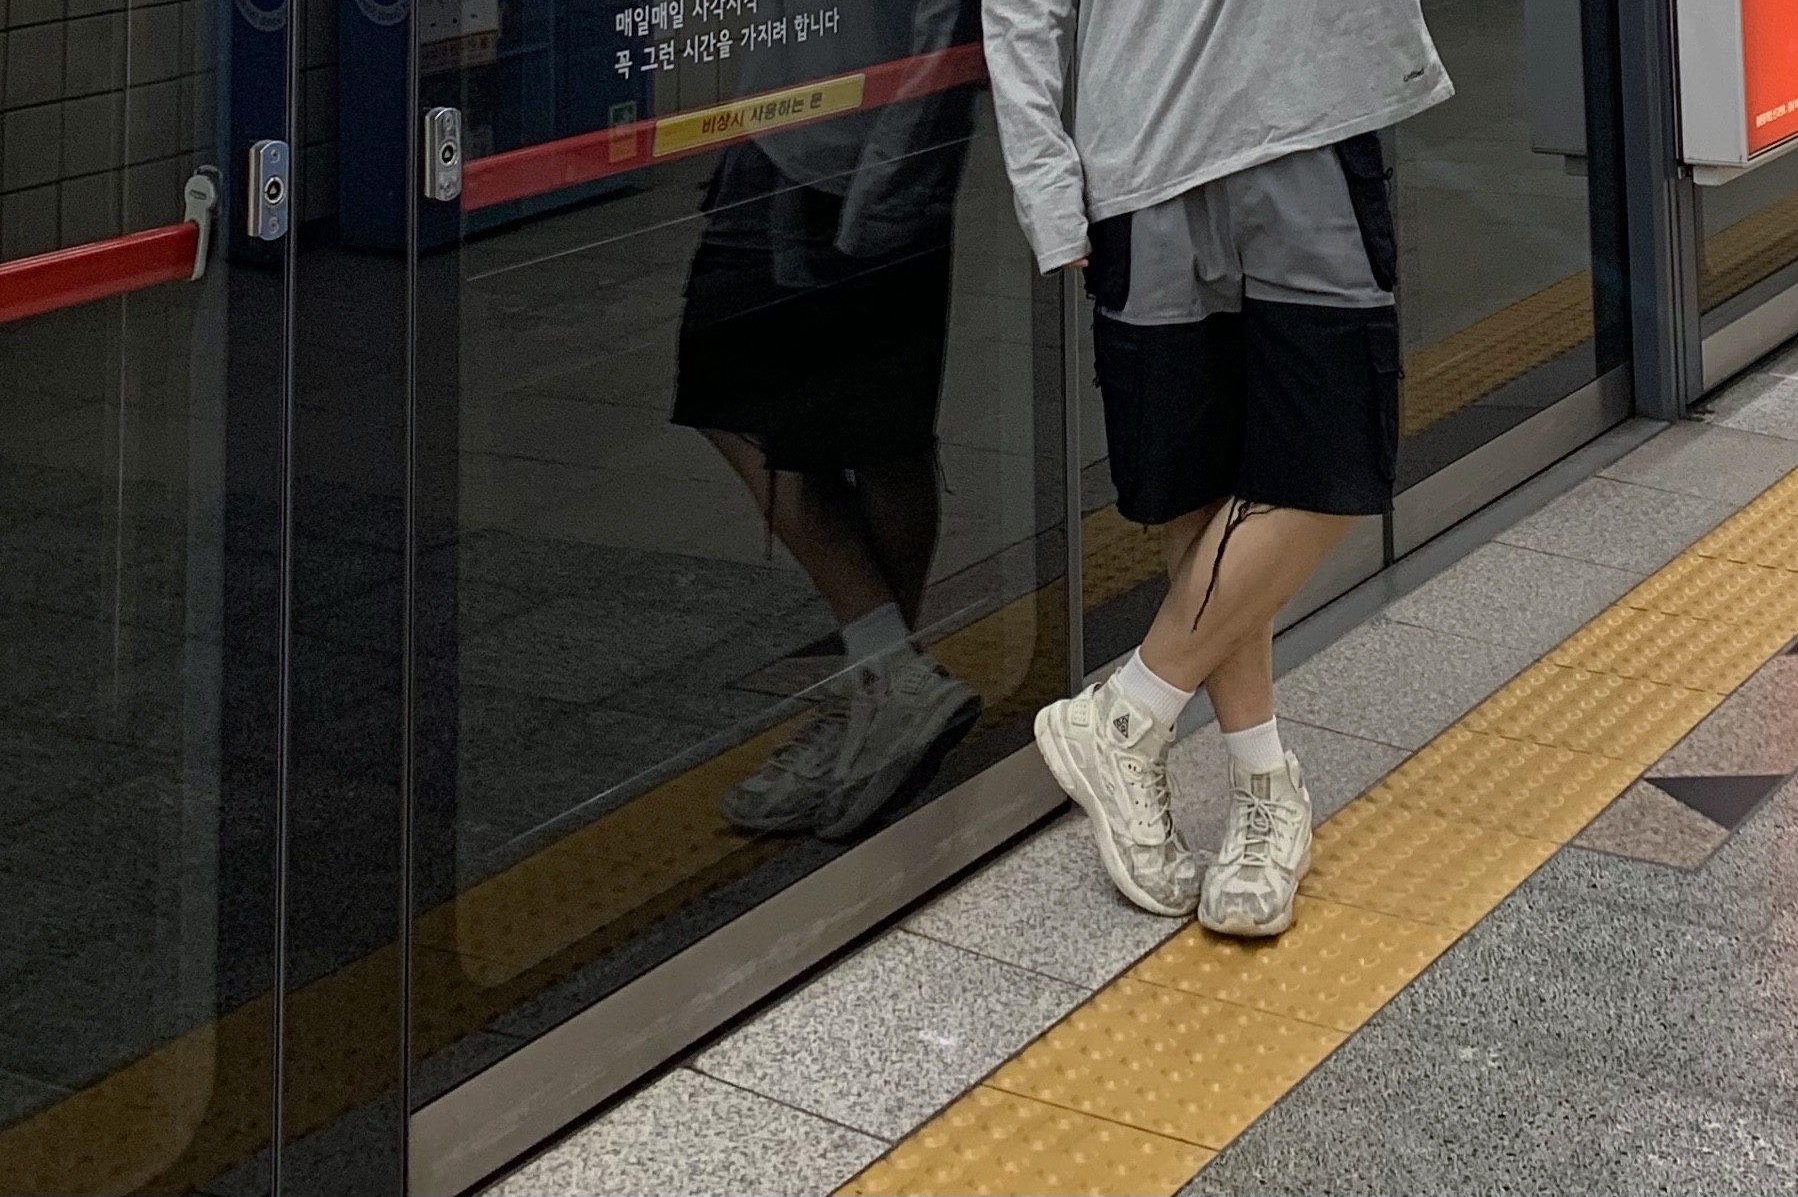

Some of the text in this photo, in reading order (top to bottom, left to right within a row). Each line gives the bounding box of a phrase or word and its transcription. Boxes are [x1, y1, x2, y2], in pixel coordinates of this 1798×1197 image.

[615, 0, 685, 38] 매일매일
[614, 6, 840, 80] 꼭 그런 시간을 가지려 합니다
[702, 92, 823, 135] 비상시 사용하는 문
